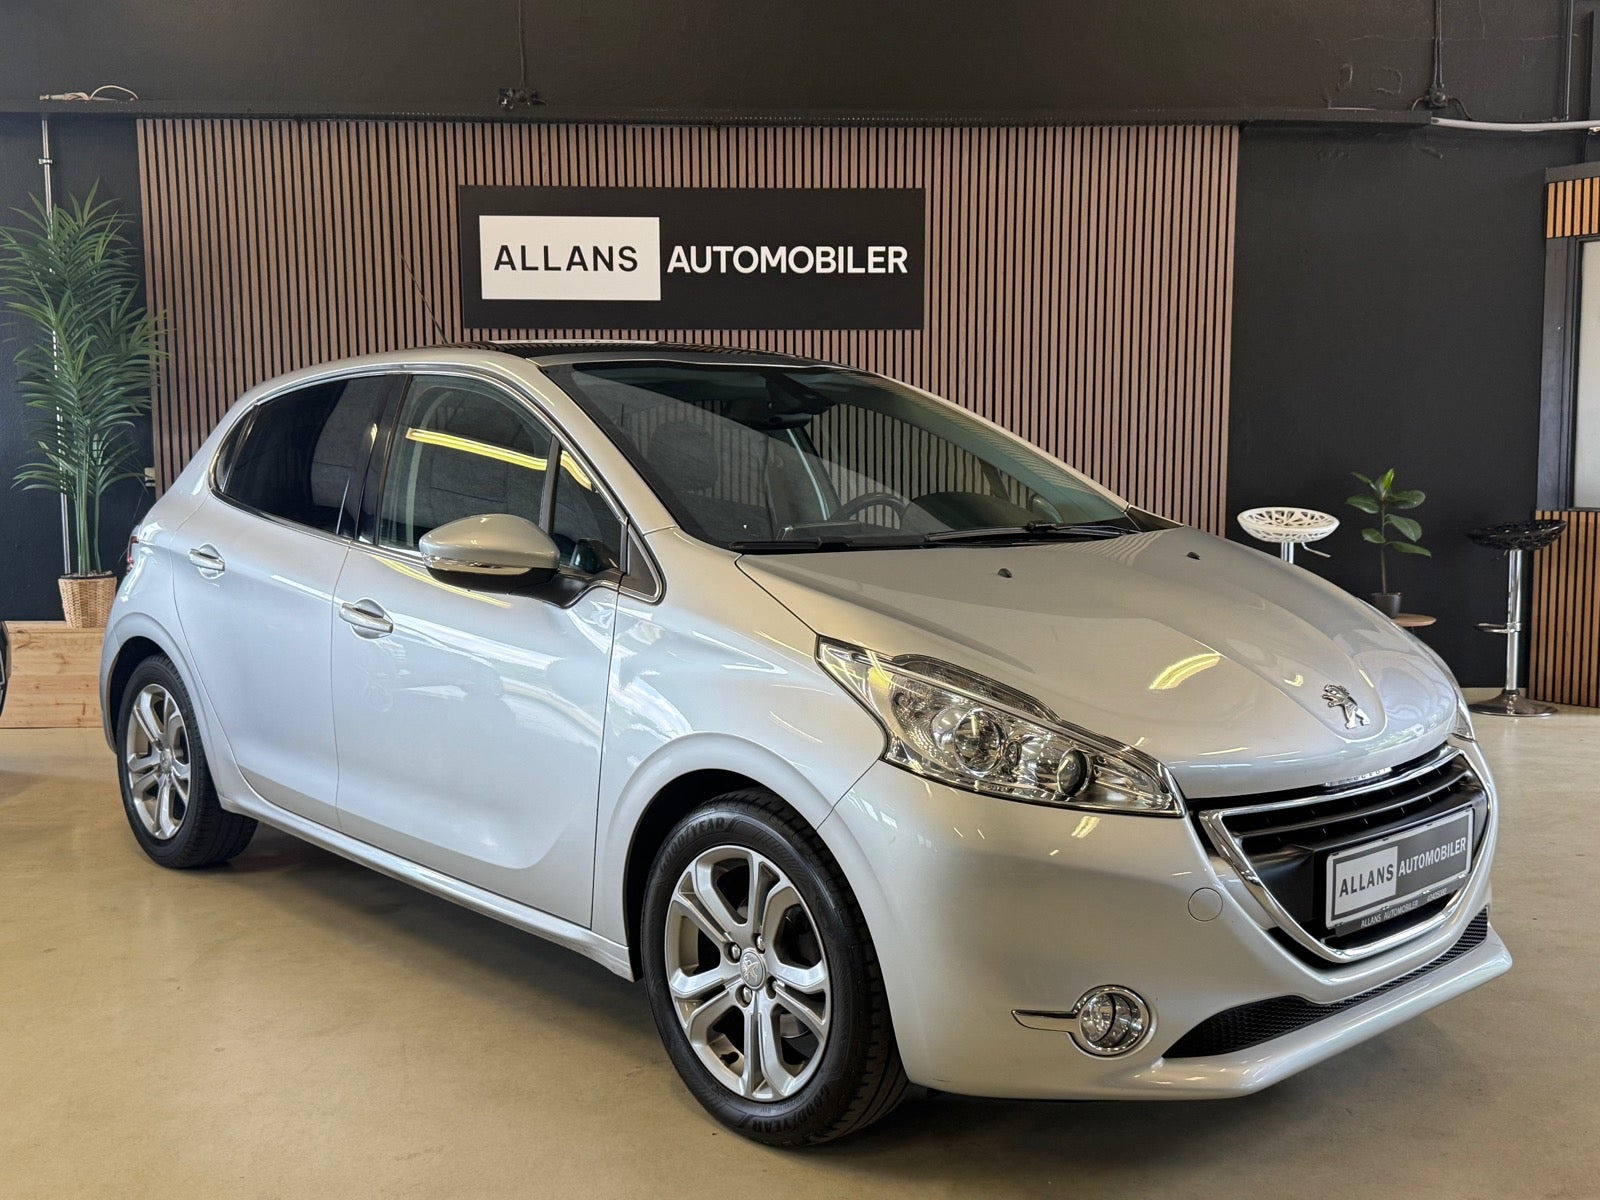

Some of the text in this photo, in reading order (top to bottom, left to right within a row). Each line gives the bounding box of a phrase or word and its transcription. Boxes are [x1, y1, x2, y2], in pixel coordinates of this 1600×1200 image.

[493, 244, 908, 274] ALLANS AUTOMOBILER
[1339, 836, 1467, 898] ALLANS AUTOMOBILER
[1360, 899, 1419, 929] ALLANS AUTOMOBILER
